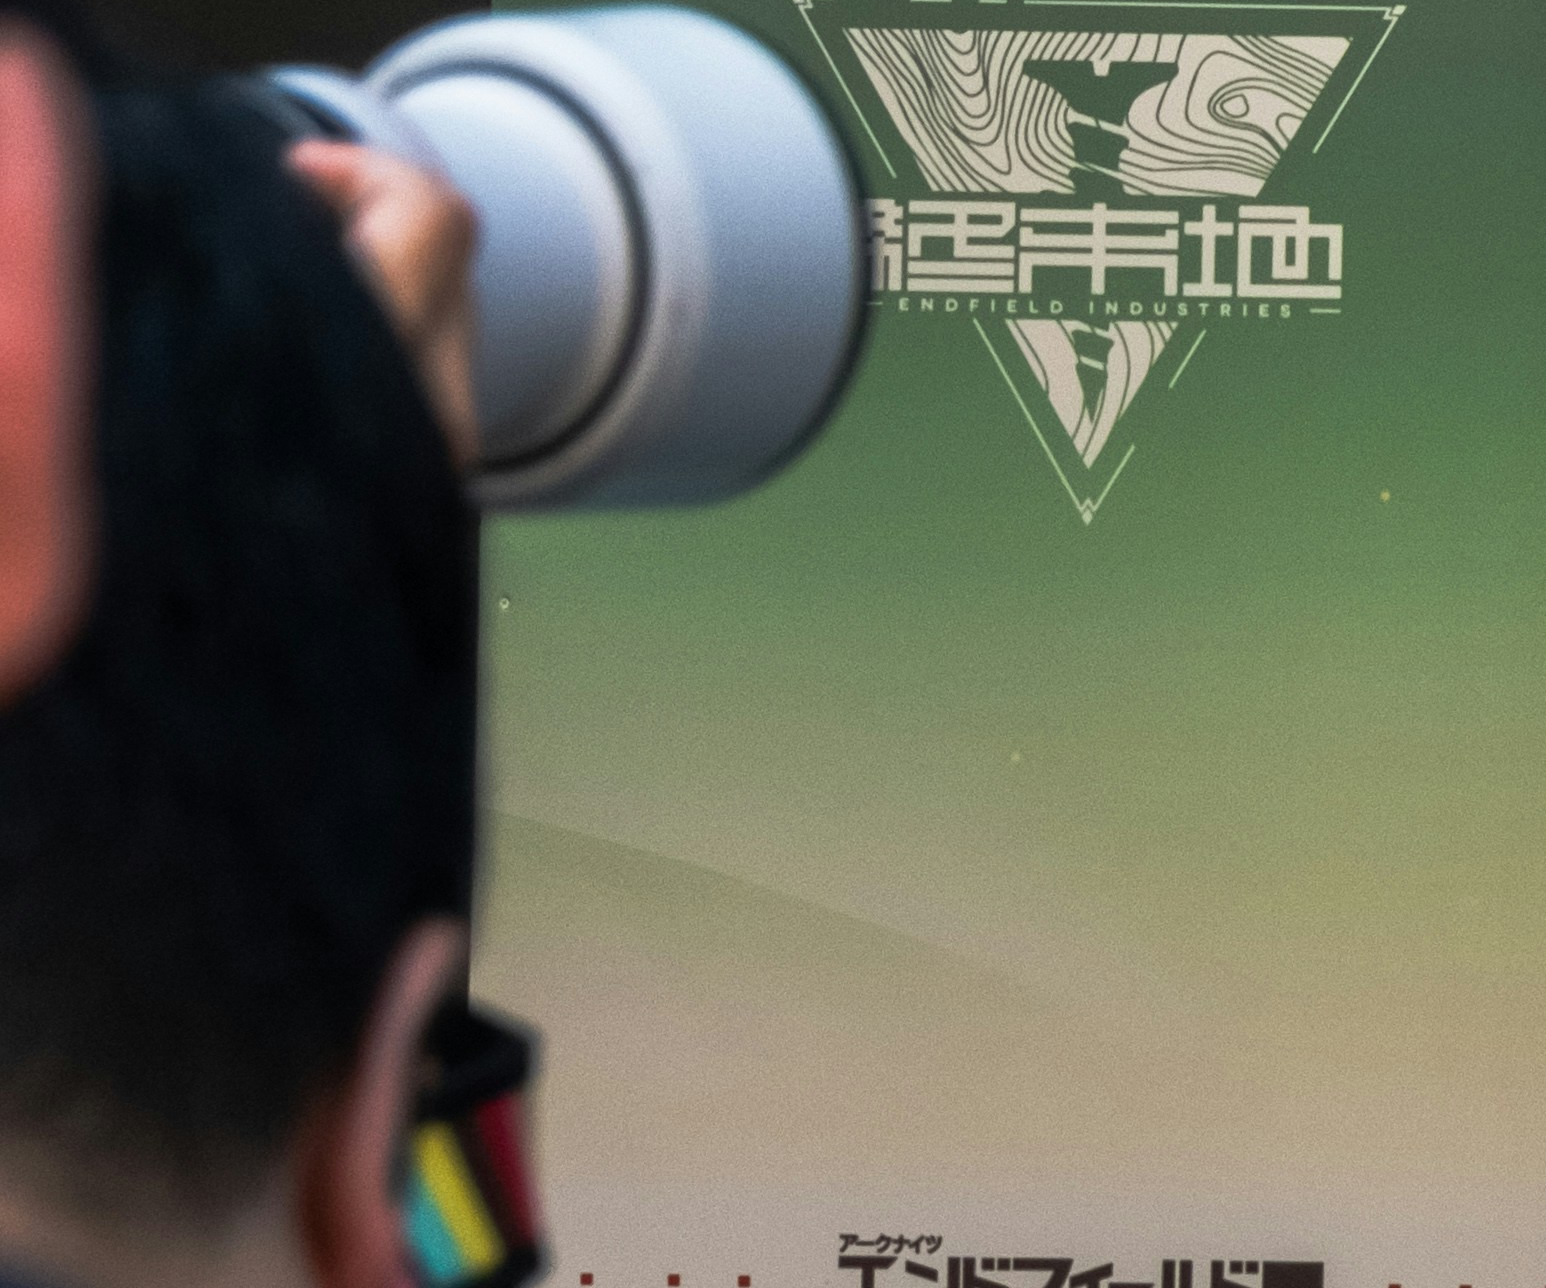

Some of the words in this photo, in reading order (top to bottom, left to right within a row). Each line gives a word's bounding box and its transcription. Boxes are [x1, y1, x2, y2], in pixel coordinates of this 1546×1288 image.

[899, 297, 1064, 314] ENDFIELD
[1090, 300, 1292, 318] INDUSTRIES
[839, 1232, 943, 1254] アークナイツ
